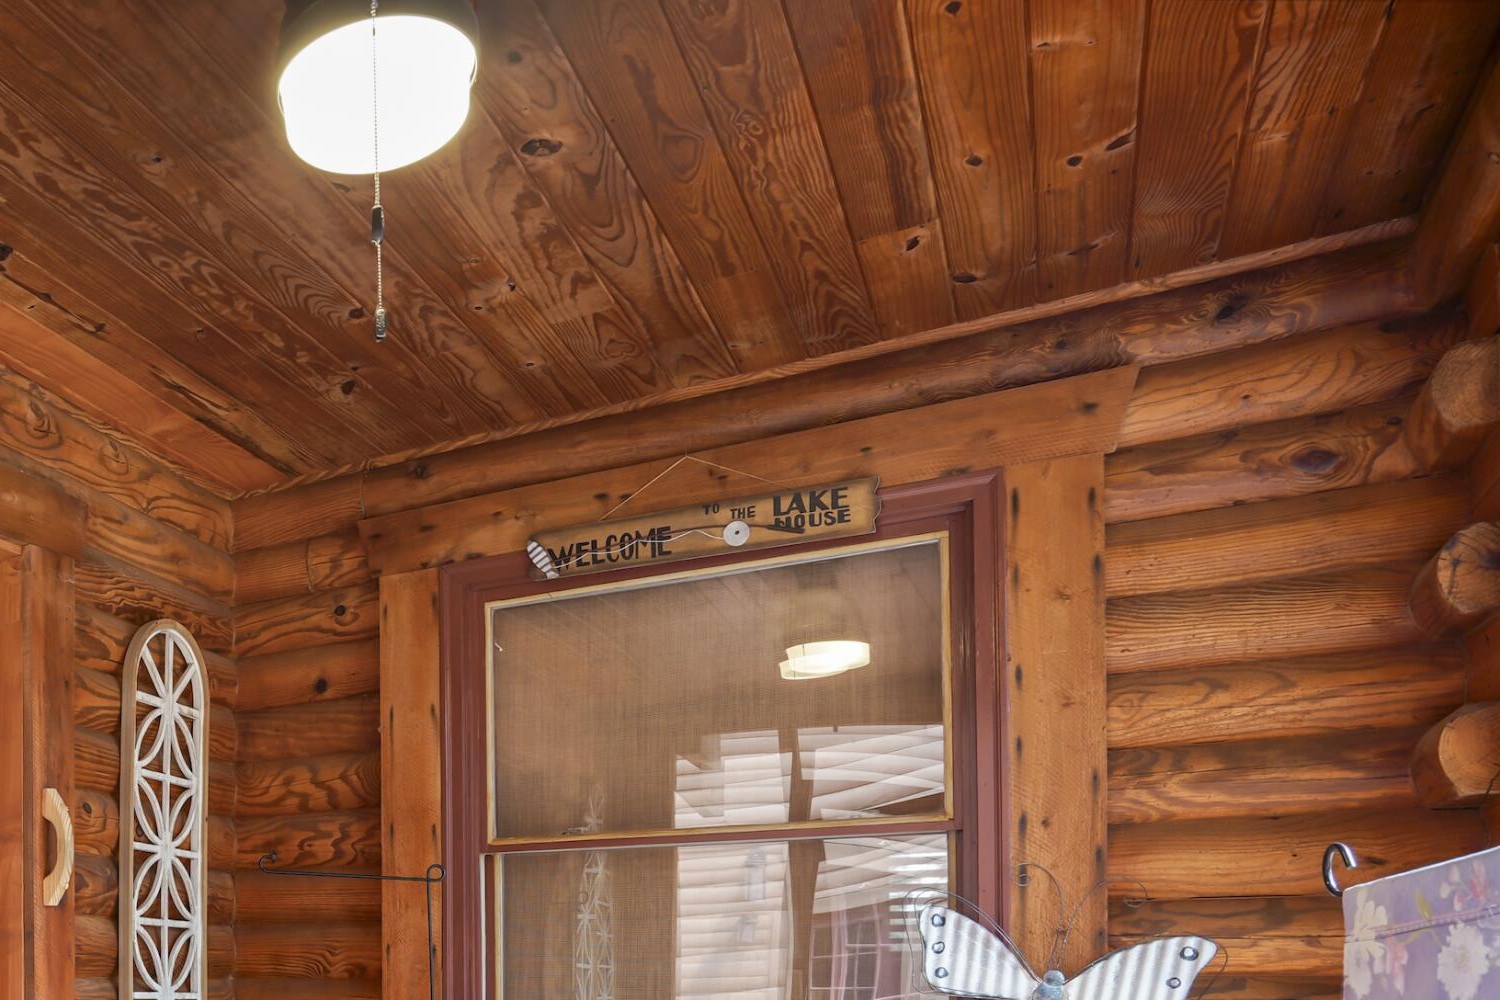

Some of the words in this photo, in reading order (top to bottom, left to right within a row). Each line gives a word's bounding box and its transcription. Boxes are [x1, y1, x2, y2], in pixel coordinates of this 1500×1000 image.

[546, 525, 673, 571] WELCOME
[701, 503, 720, 516] TO
[730, 505, 757, 520] THE
[772, 486, 850, 517] LAKE
[773, 508, 852, 530] HOUSE
